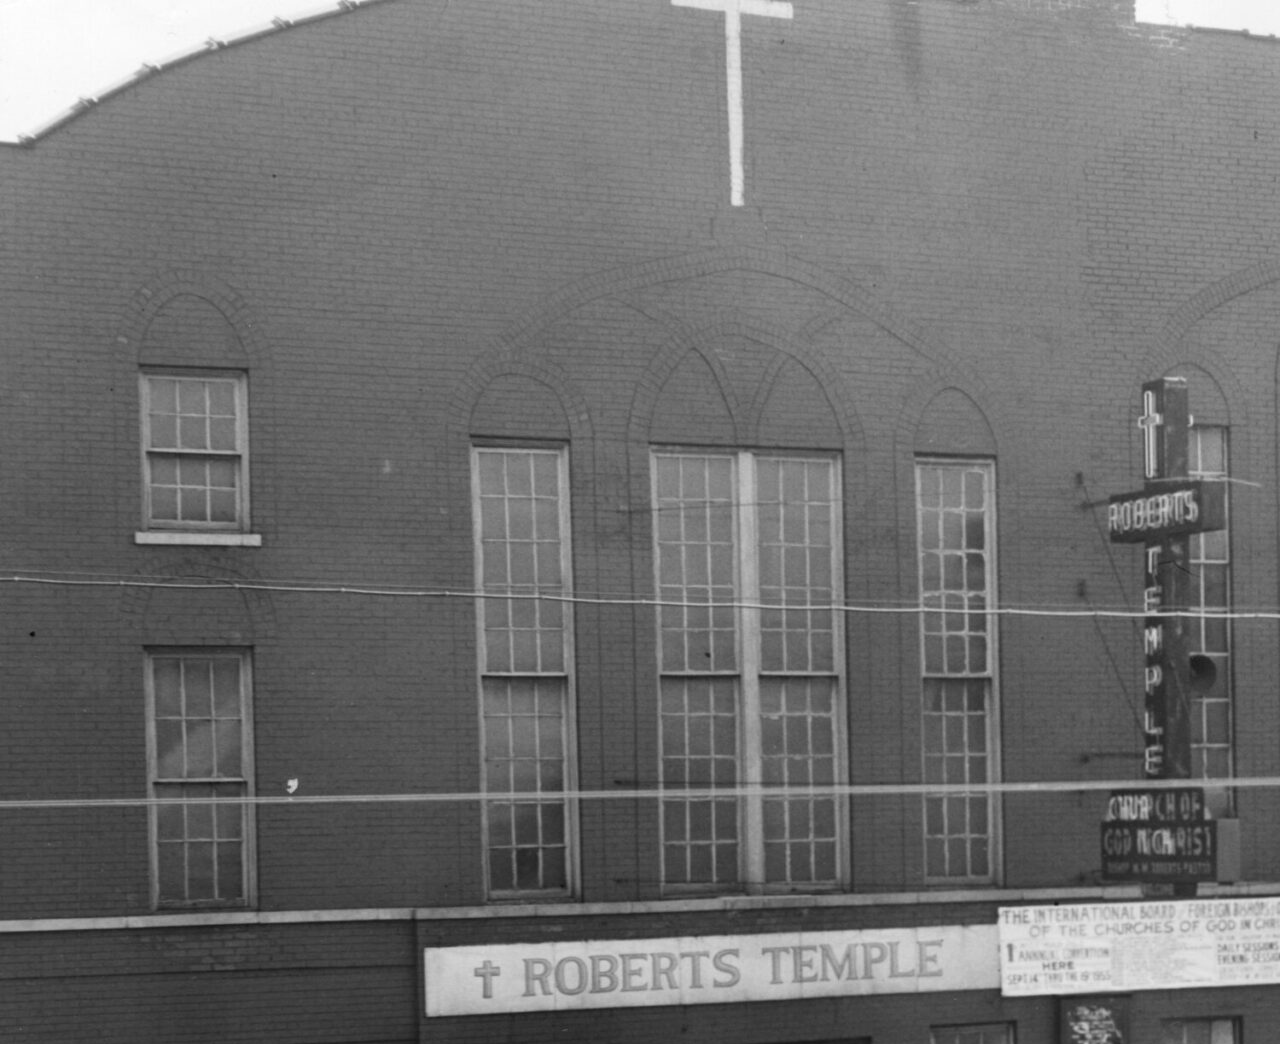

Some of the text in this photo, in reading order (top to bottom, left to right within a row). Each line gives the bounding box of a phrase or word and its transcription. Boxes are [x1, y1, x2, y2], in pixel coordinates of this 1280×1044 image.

[1109, 489, 1198, 532] ROBERTS
[1144, 545, 1163, 775] TEMPLE
[1108, 791, 1200, 821] CHURCH OF
[1104, 828, 1132, 856] GOD
[1152, 826, 1211, 856] CHRIST
[1004, 909, 1030, 924] THE
[1034, 906, 1136, 922] INTERNATIONAL
[1140, 903, 1176, 919] BOARD
[1029, 924, 1050, 938] OF
[1060, 923, 1087, 937] THE
[1094, 920, 1174, 937] CHURCHES
[1179, 919, 1200, 933] OF
[1206, 918, 1236, 932] GOD
[1240, 919, 1251, 930] IN
[522, 939, 944, 997] ROBERTS TEMPLE
[1042, 961, 1075, 971] HERE
